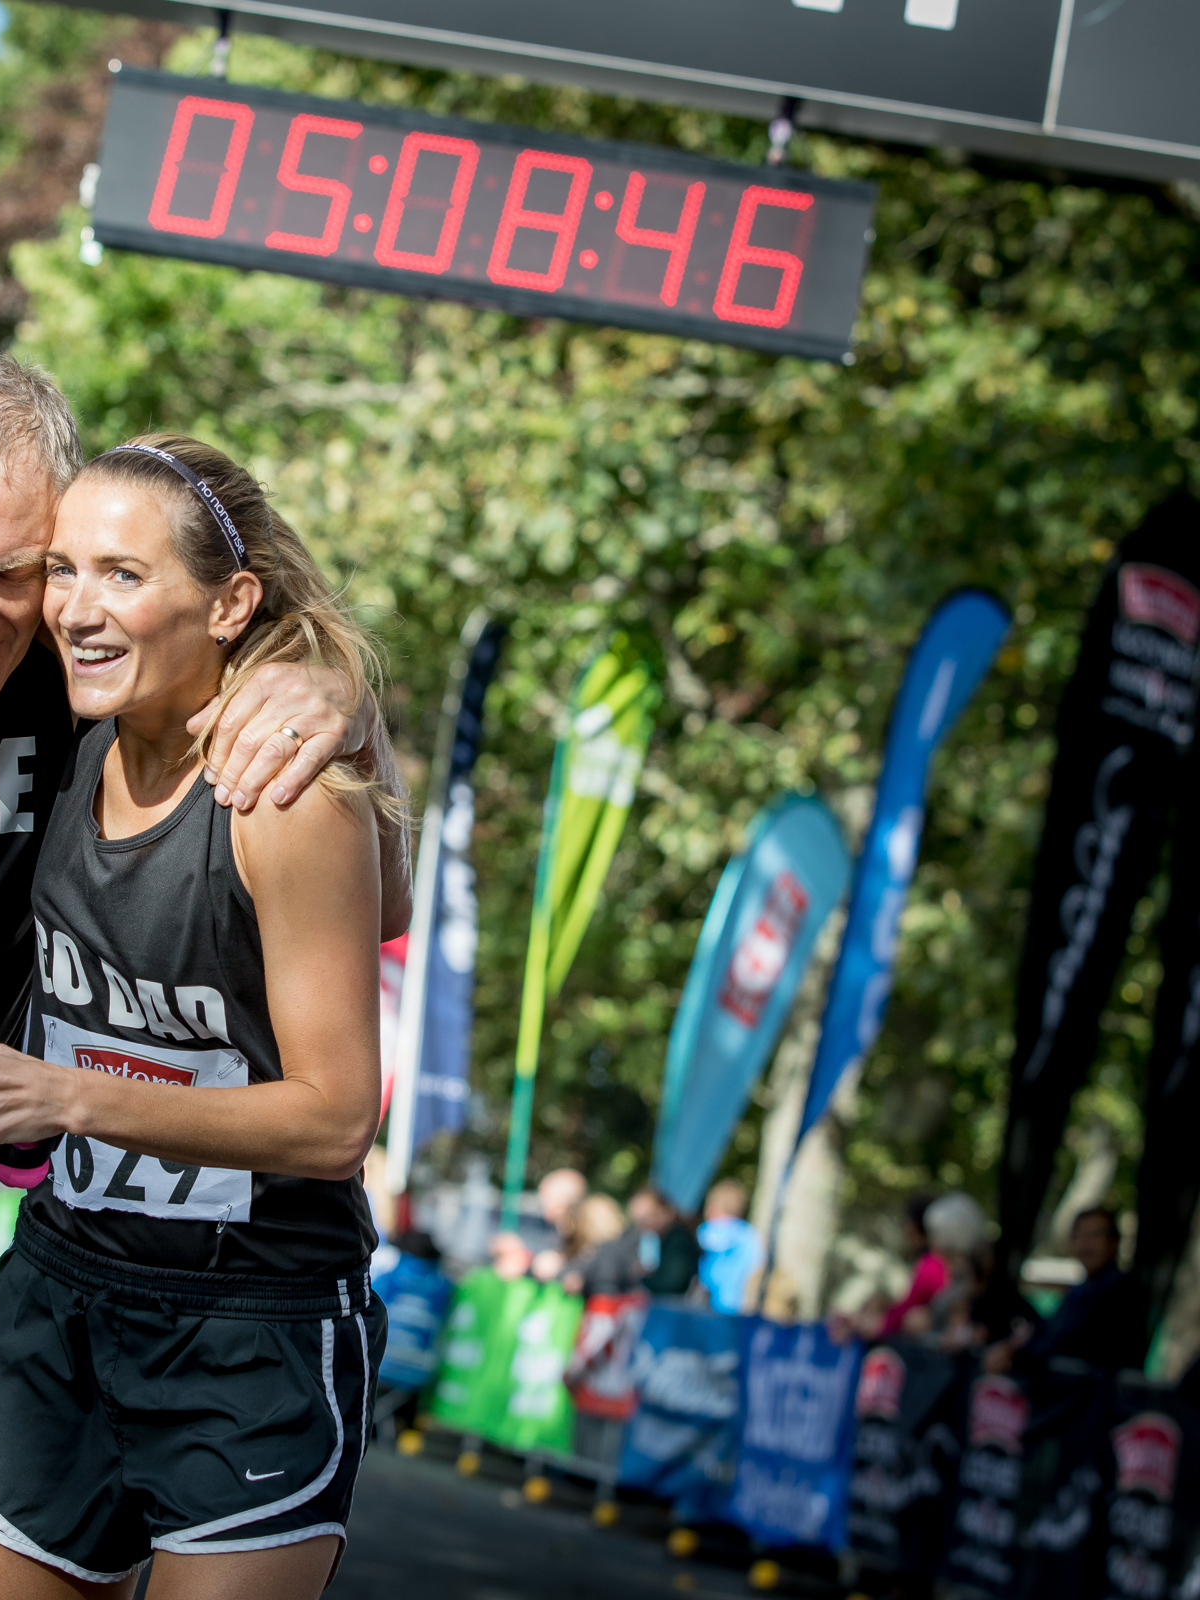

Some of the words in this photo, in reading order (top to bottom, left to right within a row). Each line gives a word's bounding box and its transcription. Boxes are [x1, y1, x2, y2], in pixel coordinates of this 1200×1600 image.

[148, 95, 814, 329] 05:08:46
[197, 480, 213, 498] no
[210, 496, 246, 558] nonsense.
